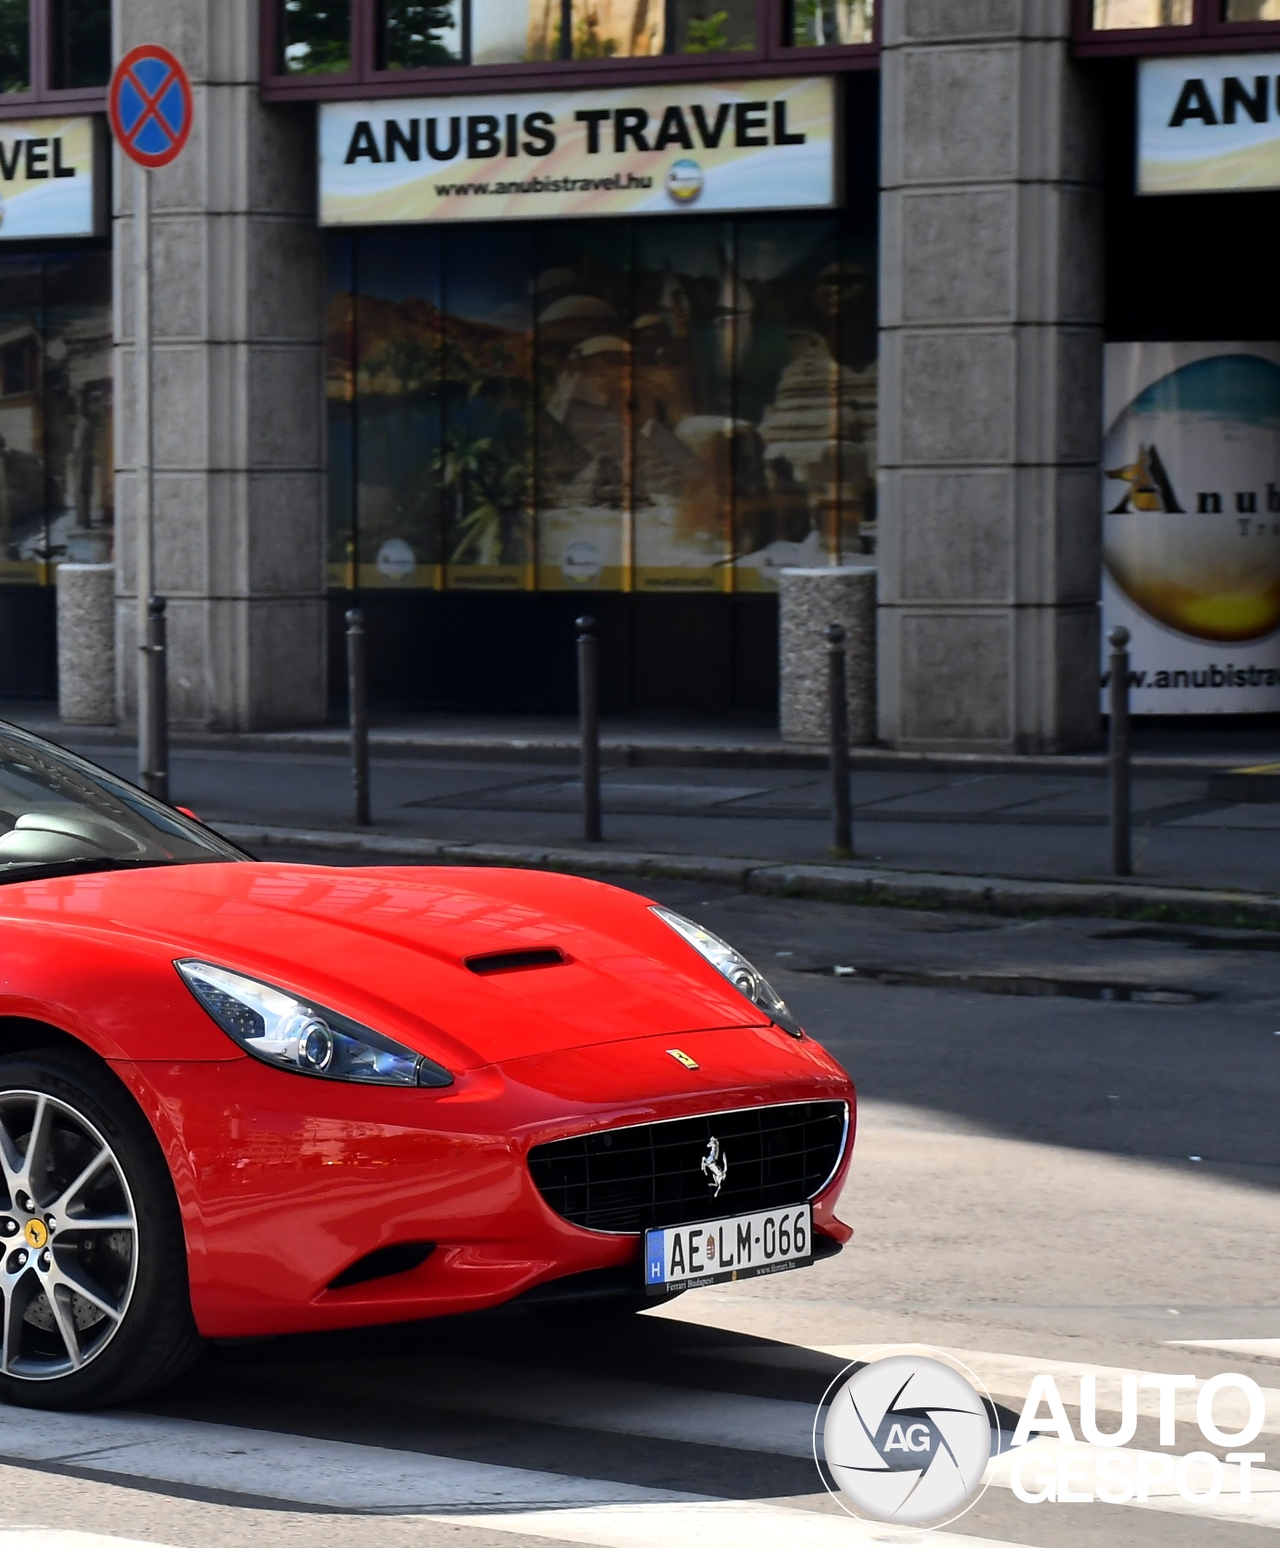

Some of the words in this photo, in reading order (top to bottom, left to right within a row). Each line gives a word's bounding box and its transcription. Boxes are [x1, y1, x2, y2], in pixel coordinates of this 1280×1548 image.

[1168, 74, 1280, 128] AN
[344, 111, 556, 164] ANUBIS
[575, 100, 805, 154] TRAVEL
[434, 172, 653, 197] www.anubistravel.hu
[651, 1262, 661, 1278] H
[666, 1280, 687, 1292] Ferrari
[687, 1276, 715, 1289] Budapest
